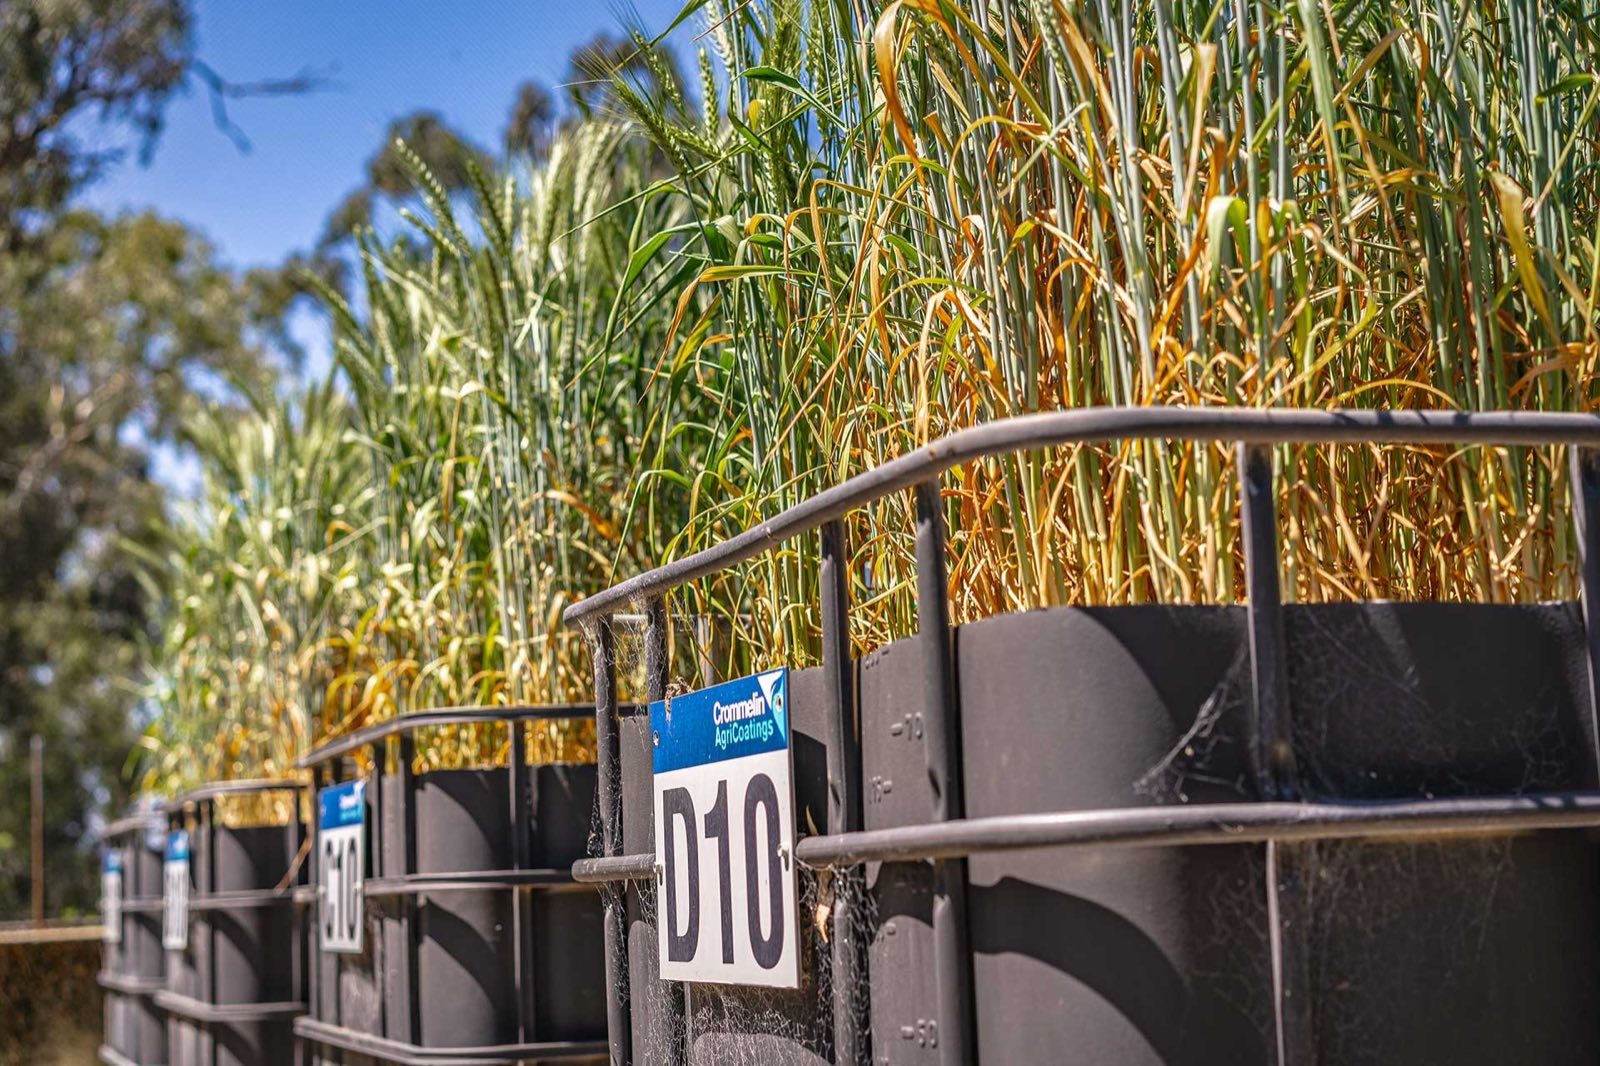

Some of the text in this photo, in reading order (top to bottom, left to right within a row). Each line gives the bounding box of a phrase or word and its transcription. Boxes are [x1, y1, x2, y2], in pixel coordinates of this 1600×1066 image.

[713, 691, 765, 725] Crommelin
[715, 718, 774, 750] AgriCoatings
[663, 772, 786, 970] D10
